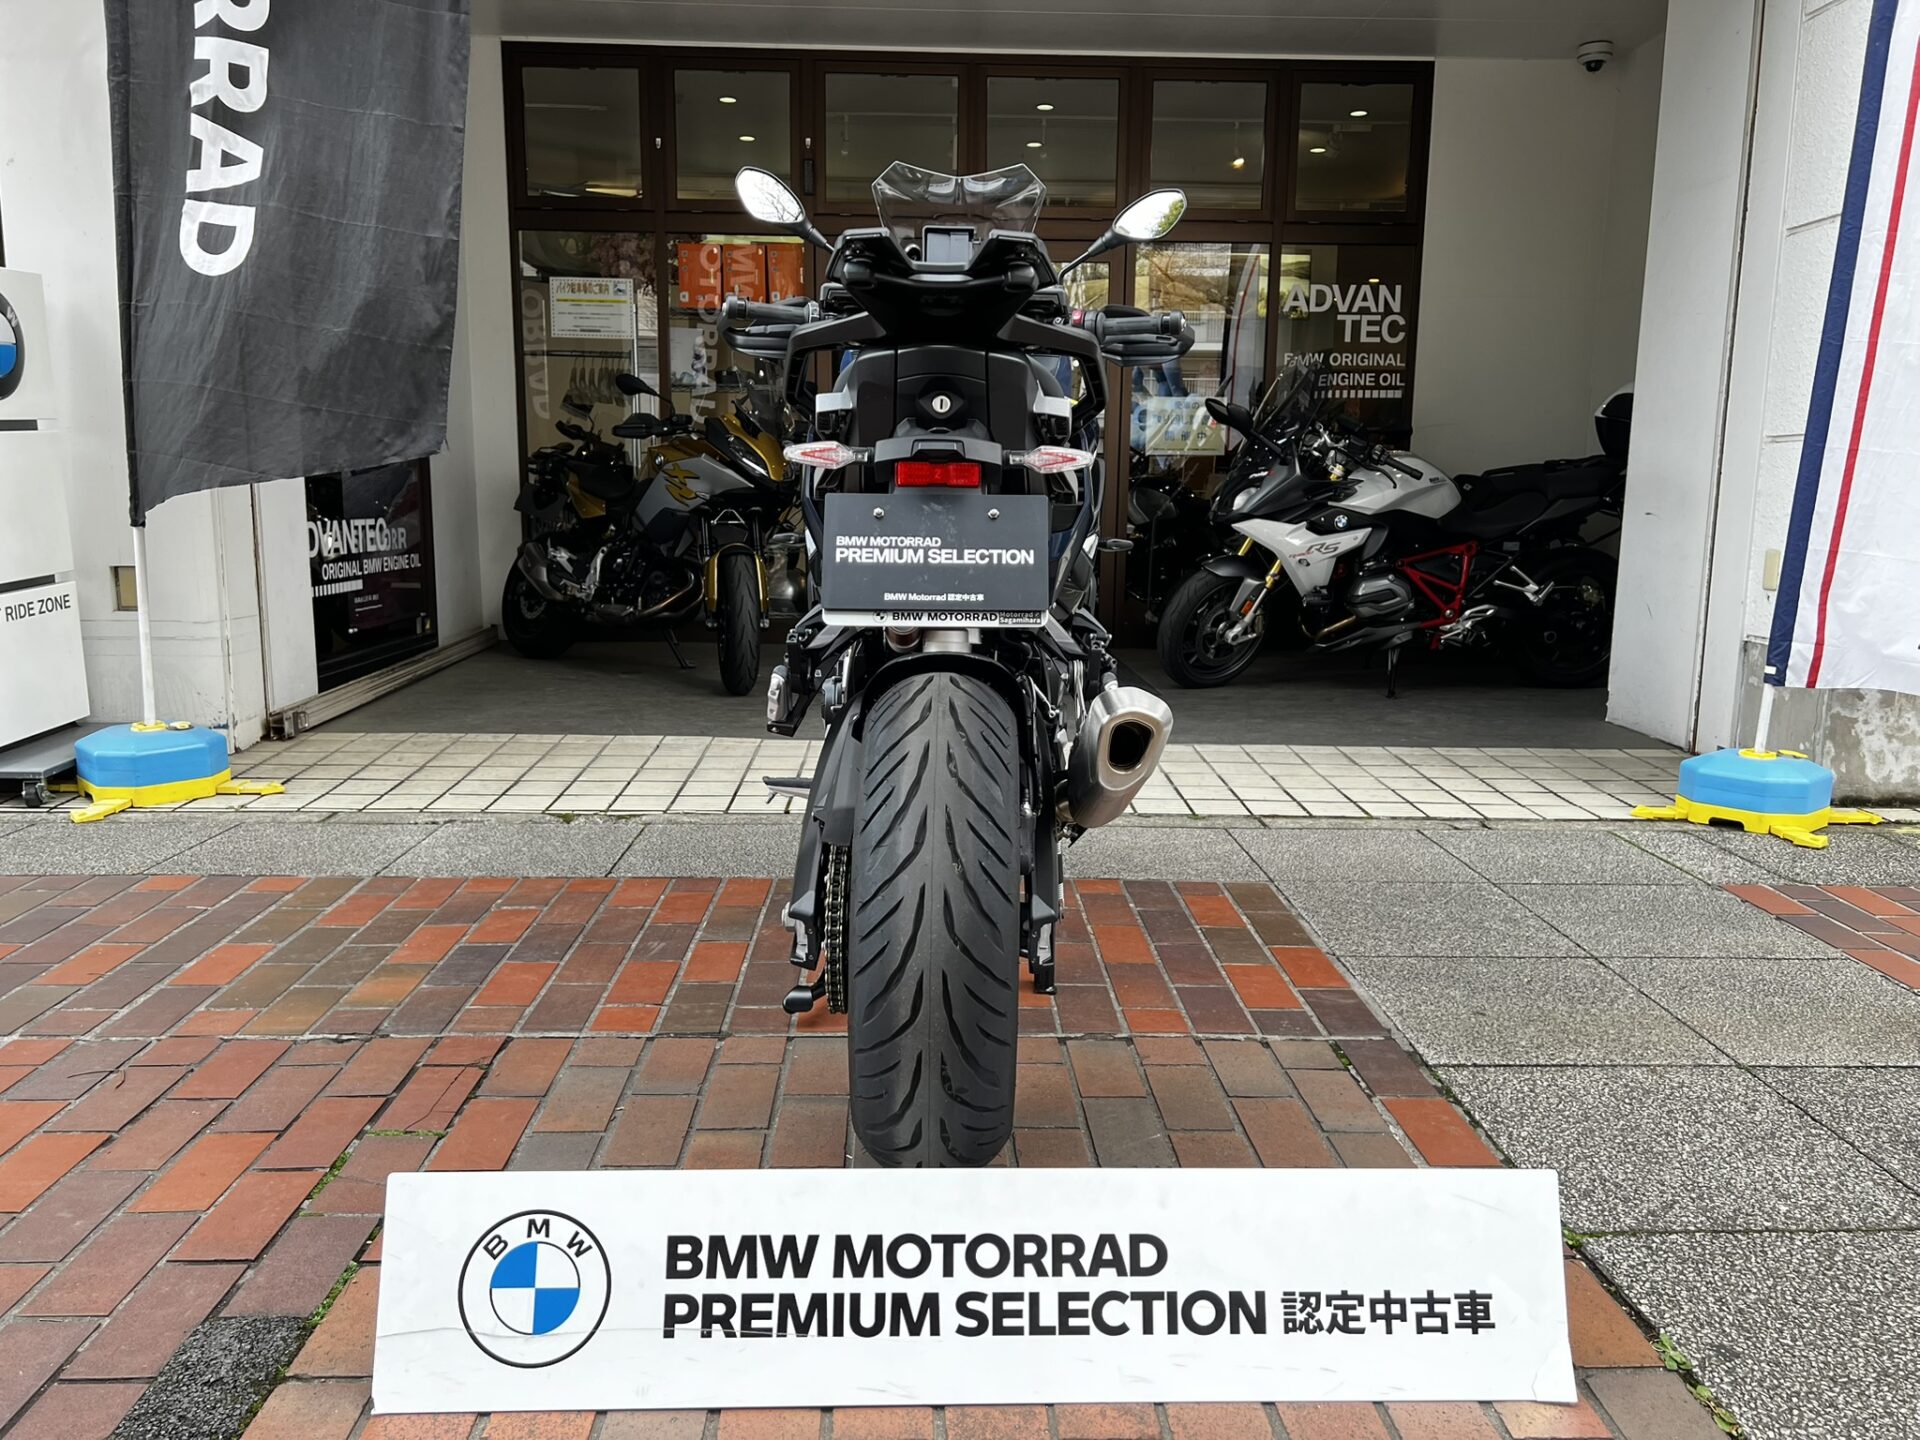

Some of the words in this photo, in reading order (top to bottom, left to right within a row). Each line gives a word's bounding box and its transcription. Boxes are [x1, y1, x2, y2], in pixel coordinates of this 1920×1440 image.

[1282, 284, 1402, 313] ADVAN
[1337, 314, 1406, 344] TEC
[1329, 352, 1406, 367] ORIGINAL
[1318, 372, 1376, 387] ENGINE
[1379, 372, 1406, 387] OIL
[836, 536, 868, 547] BMW
[869, 536, 942, 547] MOTORRAD
[322, 560, 362, 580] ORIGINAL
[363, 557, 383, 575] BMW
[383, 554, 409, 572] ENGINE
[409, 553, 421, 568] OIL
[835, 548, 924, 564] PREMIUM
[927, 548, 1035, 565] SELECTION
[5, 601, 36, 622] RIDE
[37, 594, 71, 615] ZONE
[883, 592, 908, 601] BMW
[908, 592, 947, 602] Motorrad
[892, 612, 924, 622] BMW
[926, 612, 998, 622] MOTORRAD
[999, 617, 1041, 625] Sagamihara
[483, 1218, 593, 1261] BMW
[666, 1234, 820, 1279] BMW
[832, 1232, 1169, 1279] MOTORRAD
[663, 1291, 941, 1339] PREMIUM
[954, 1289, 1267, 1338] SELECTION
[1280, 1288, 1497, 1336] 認定中古車
